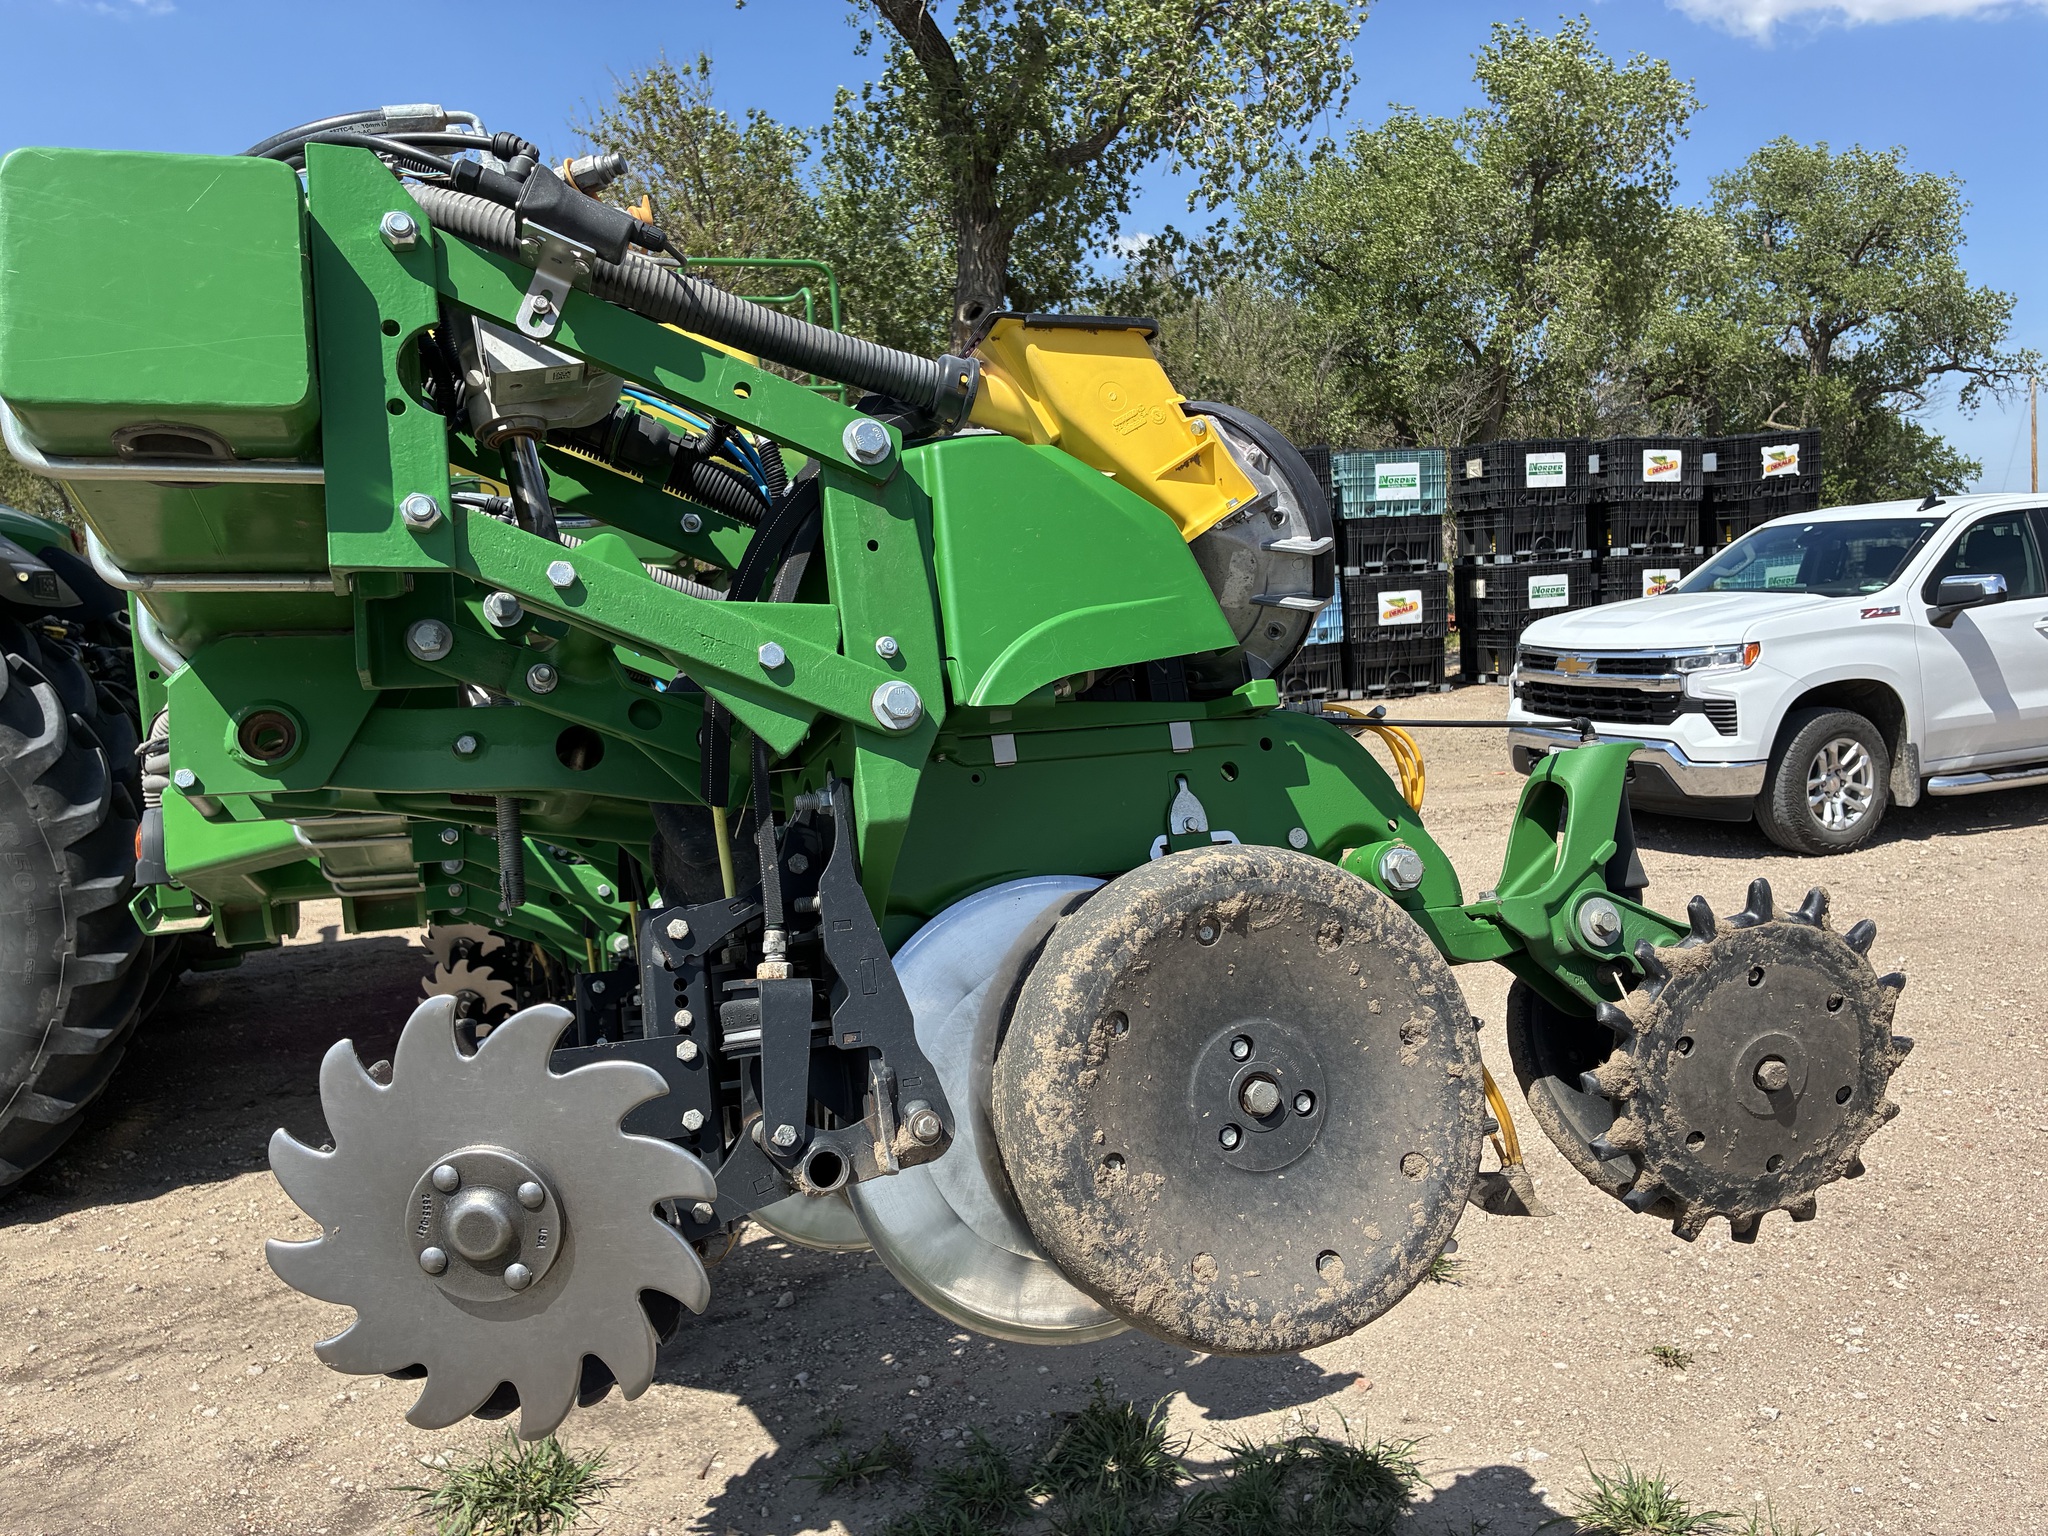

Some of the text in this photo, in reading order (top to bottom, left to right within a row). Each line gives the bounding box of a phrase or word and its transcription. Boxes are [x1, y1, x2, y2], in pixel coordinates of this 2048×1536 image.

[1652, 463, 1674, 474] DEKALB
[1770, 457, 1792, 470] DEKALB
[1388, 604, 1414, 617] DEKALB
[536, 1228, 548, 1248] USA
